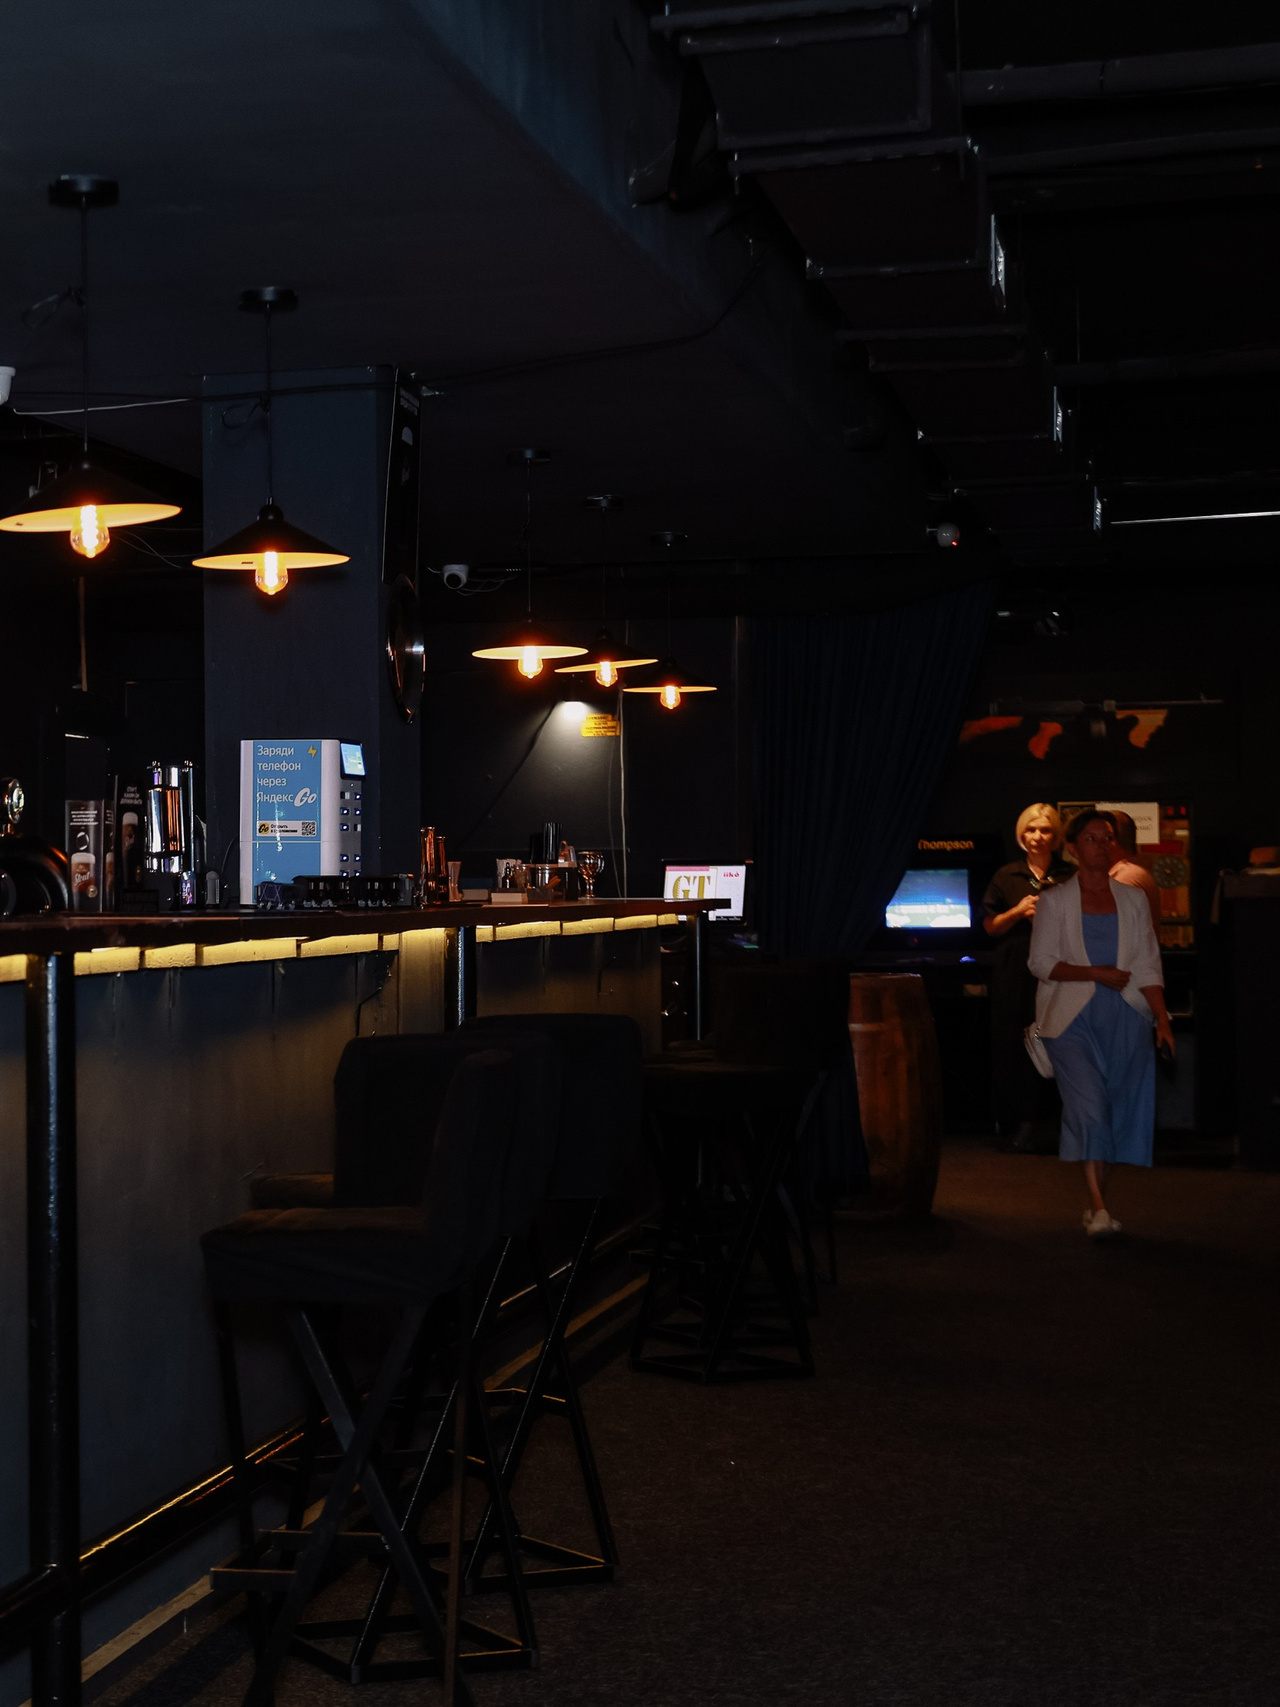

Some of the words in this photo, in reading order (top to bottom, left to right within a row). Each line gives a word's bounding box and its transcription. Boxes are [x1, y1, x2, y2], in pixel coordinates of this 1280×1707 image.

[257, 745, 294, 756] Заряди
[257, 761, 301, 772] телефон
[257, 778, 286, 787] через
[257, 791, 294, 803] Яндекс
[294, 788, 317, 806] Go
[673, 876, 710, 899] GT
